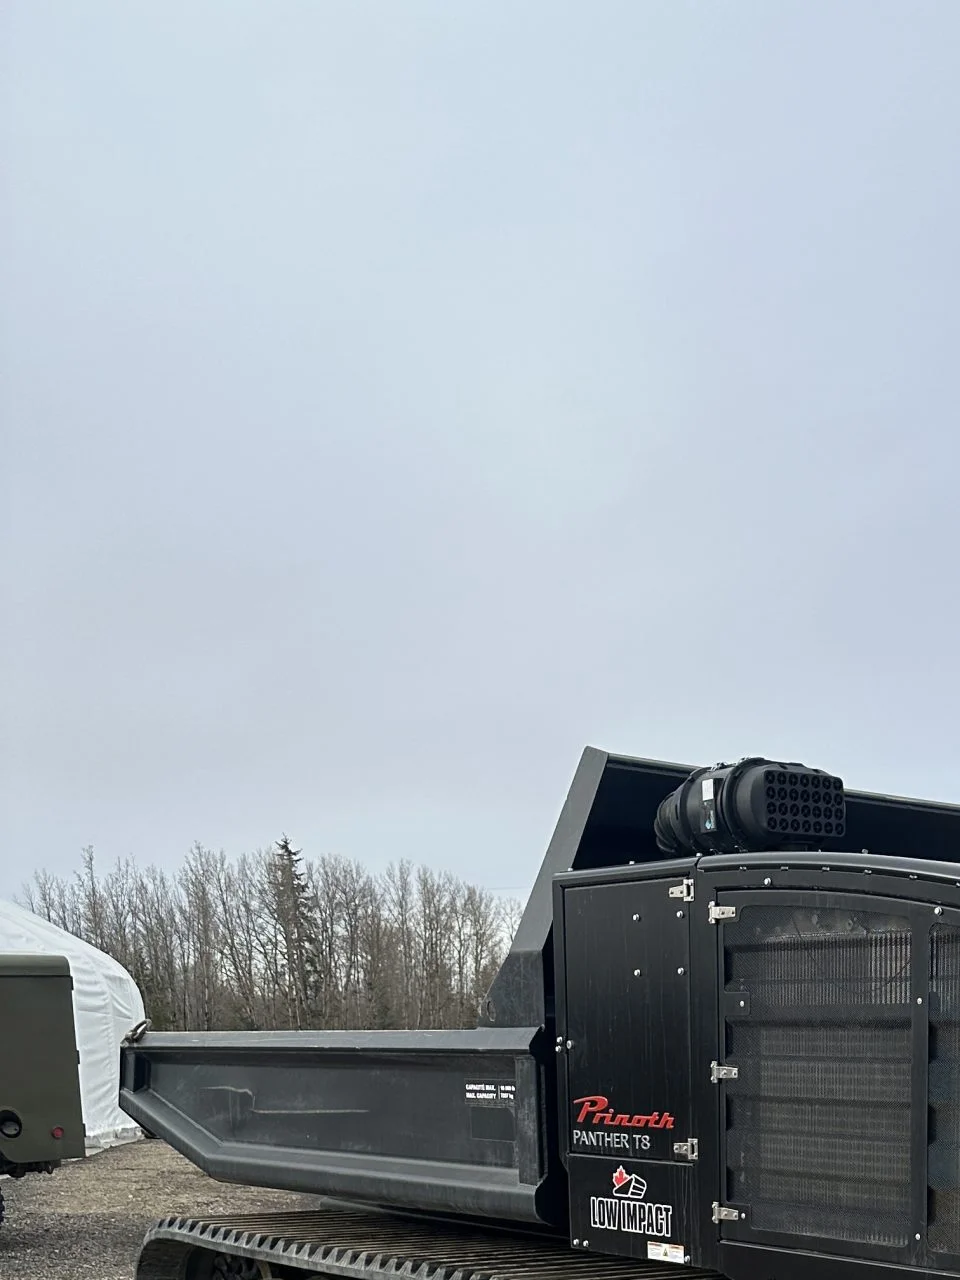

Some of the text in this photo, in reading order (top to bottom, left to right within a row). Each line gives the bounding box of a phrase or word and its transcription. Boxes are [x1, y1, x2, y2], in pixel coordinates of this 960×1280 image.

[573, 1095, 675, 1129] Prinoth
[573, 1129, 651, 1150] PANTHER T8
[590, 1196, 673, 1238] LOW IMPACT
